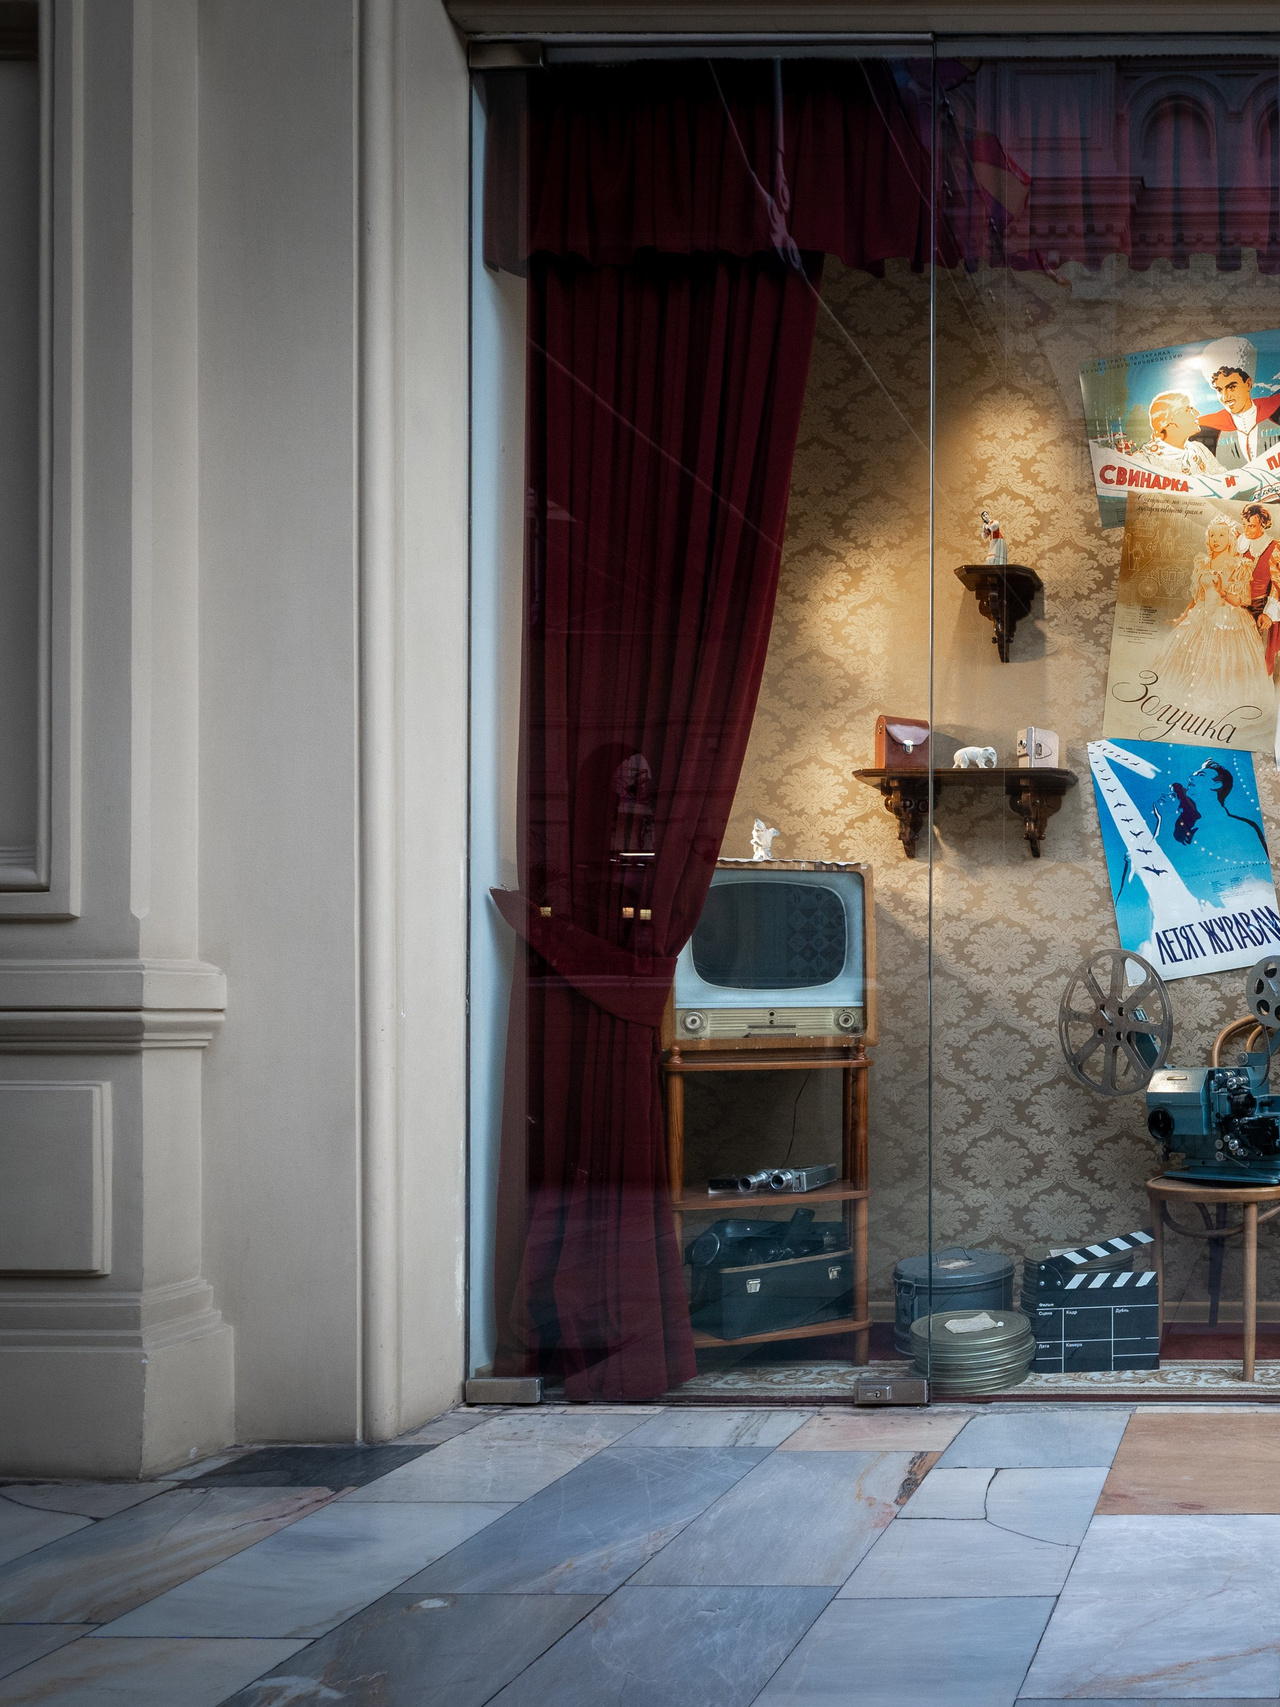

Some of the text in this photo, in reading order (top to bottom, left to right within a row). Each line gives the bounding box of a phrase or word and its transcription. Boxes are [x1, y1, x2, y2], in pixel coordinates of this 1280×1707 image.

[1099, 464, 1190, 493] СВИНАРКА
[1225, 476, 1236, 488] И
[1111, 670, 1263, 745] Золушка
[1154, 922, 1207, 966] ЛЕТЯТ
